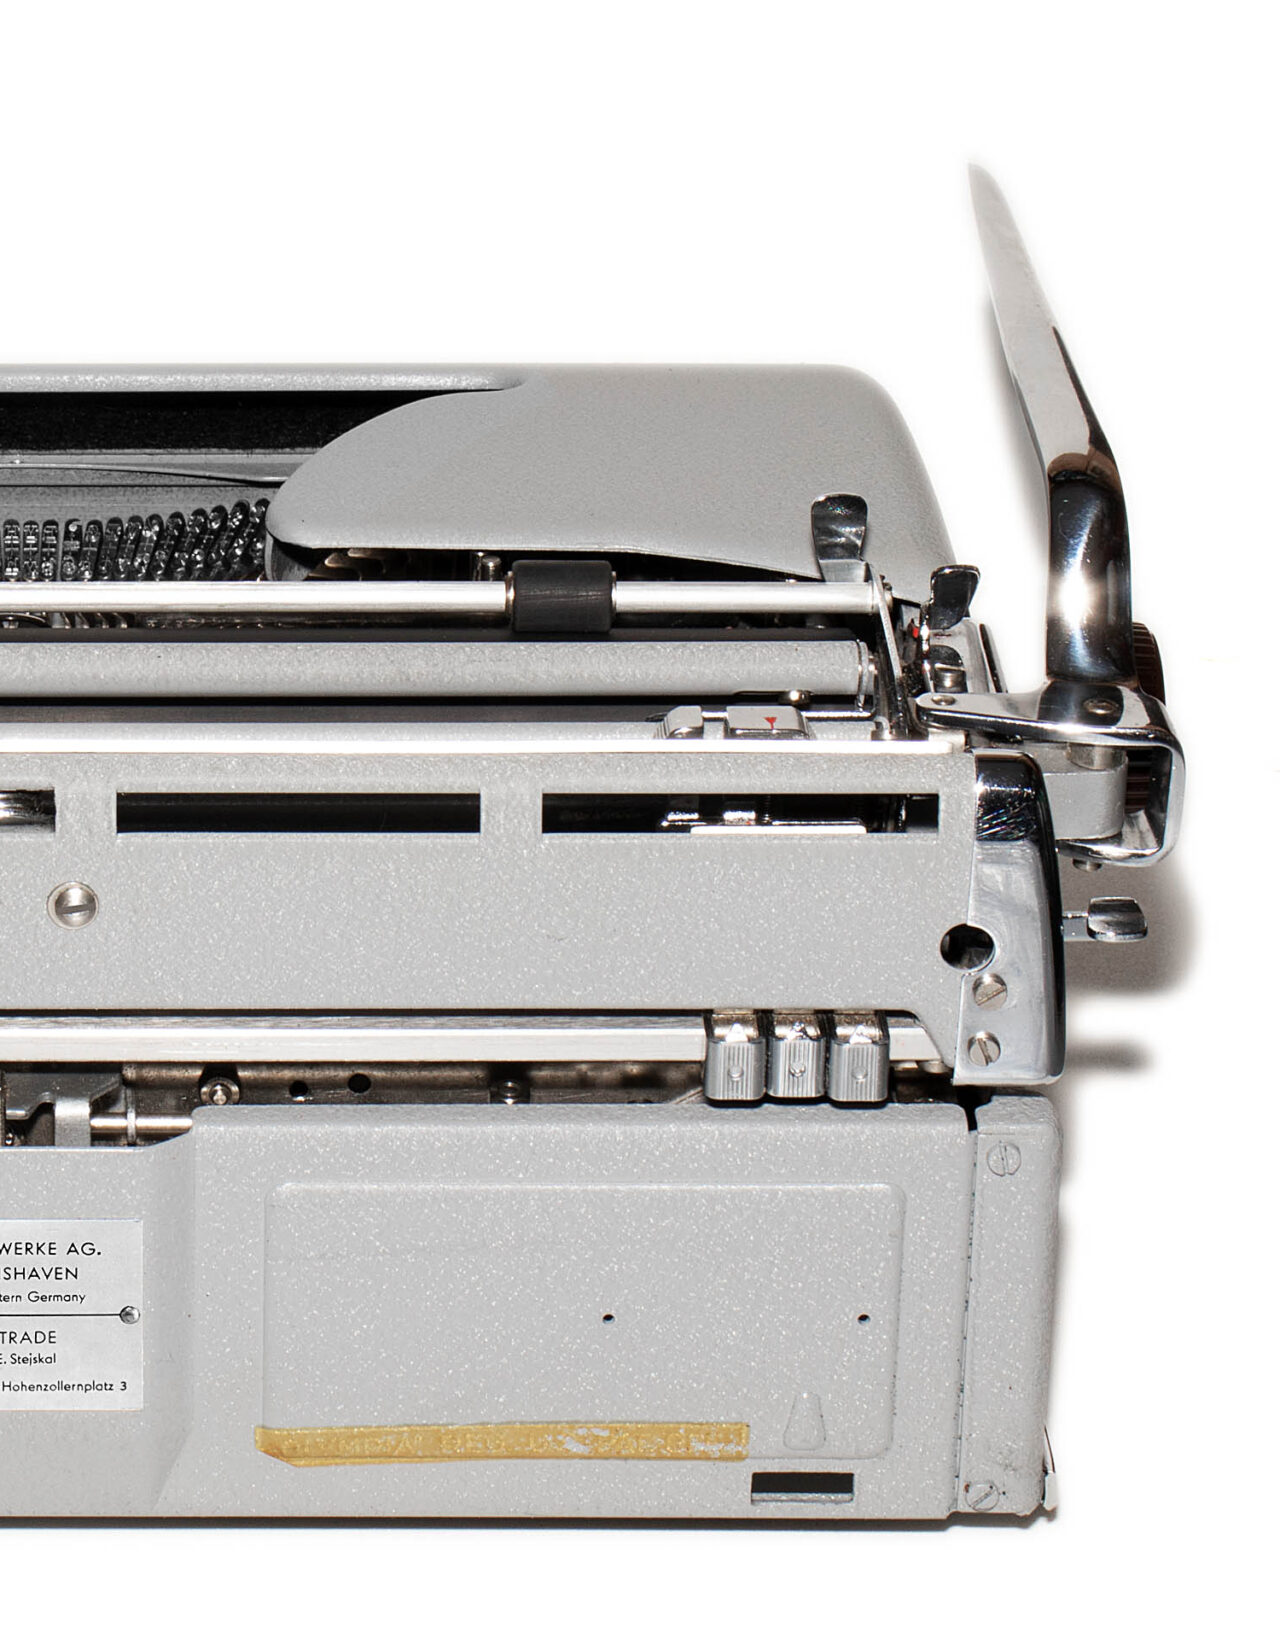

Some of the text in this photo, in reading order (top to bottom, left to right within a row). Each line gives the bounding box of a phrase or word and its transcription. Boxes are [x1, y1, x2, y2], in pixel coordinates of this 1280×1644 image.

[66, 1241, 102, 1256] AG.
[27, 1290, 86, 1305] Germany
[10, 1352, 56, 1367] Stejskal
[1, 1380, 127, 1394] Hohenzollernplatz 3
